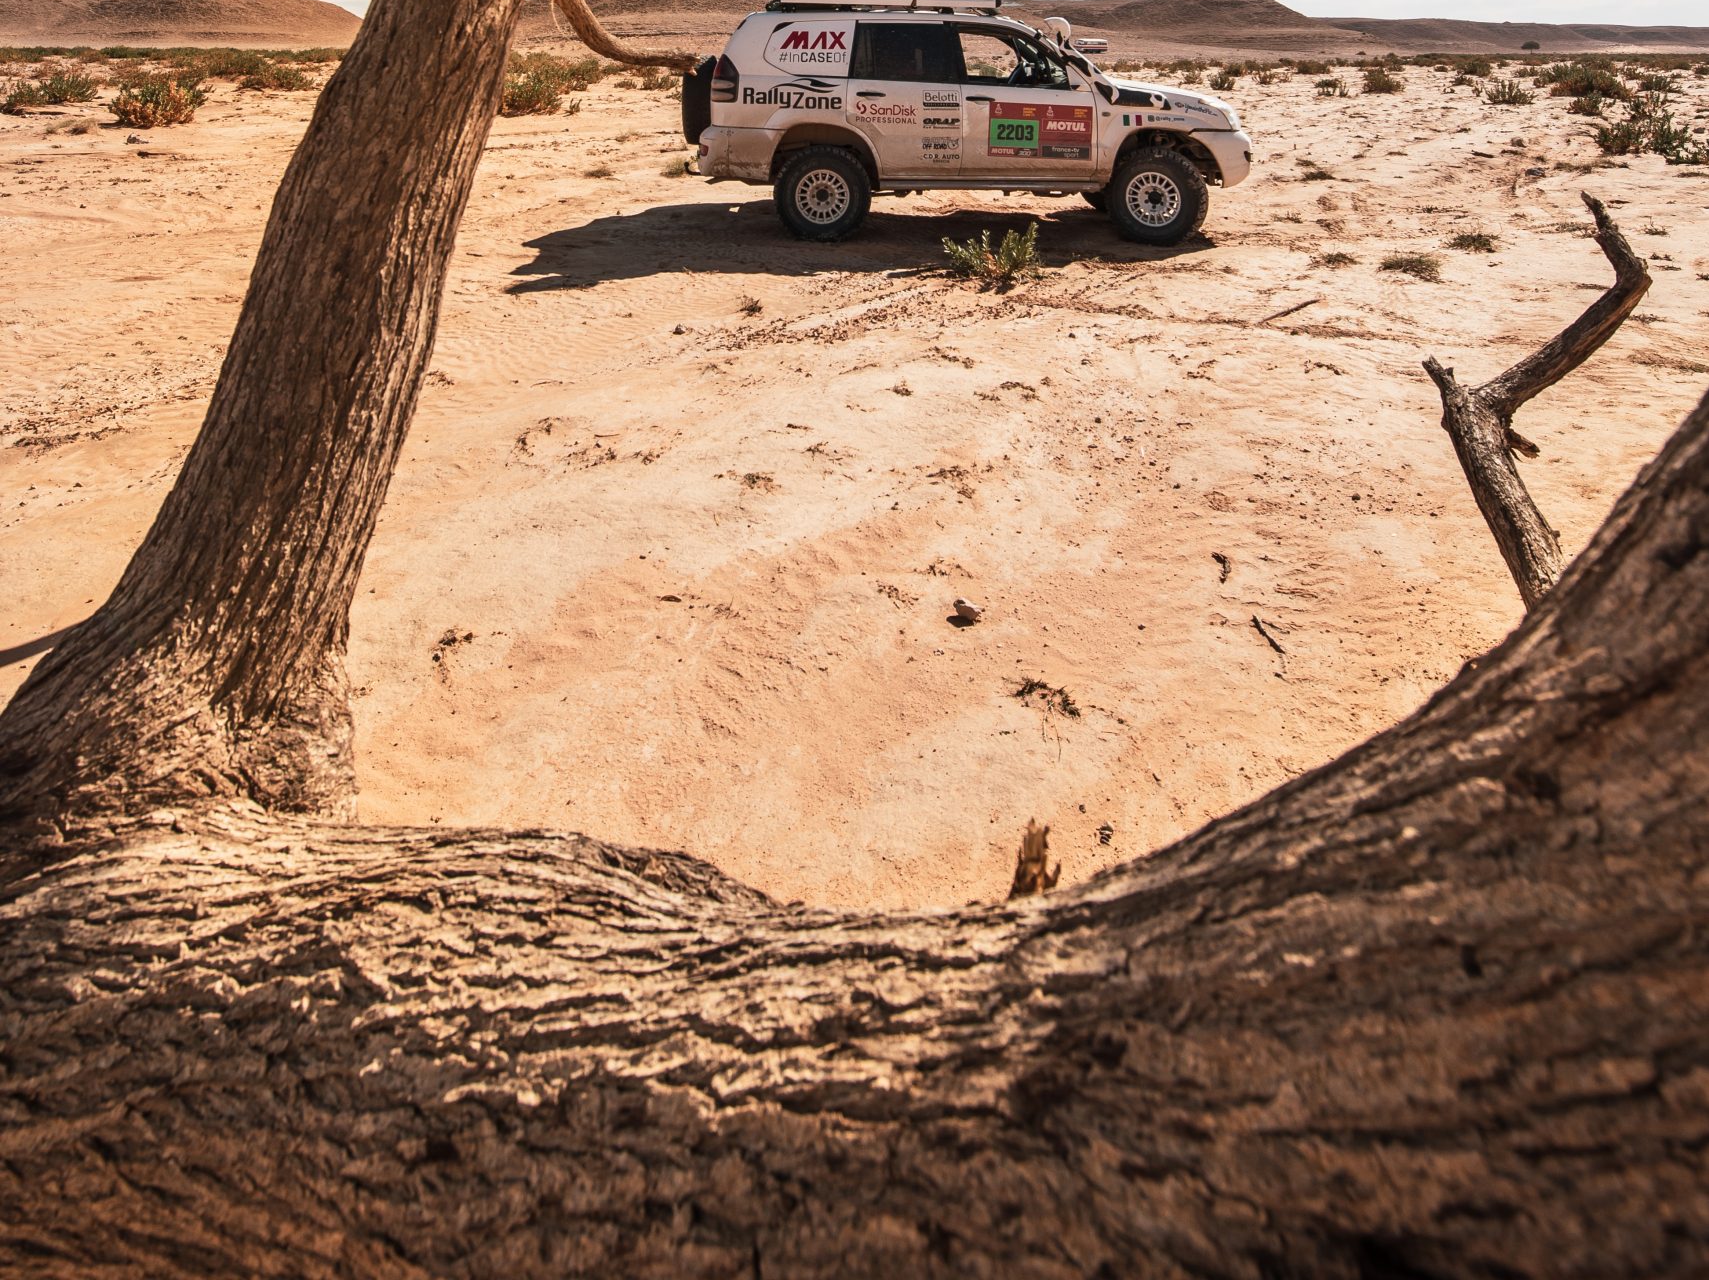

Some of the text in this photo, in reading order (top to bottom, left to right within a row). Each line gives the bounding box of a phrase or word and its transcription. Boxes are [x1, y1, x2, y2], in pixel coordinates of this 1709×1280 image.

[780, 31, 847, 50] MAX
[779, 52, 847, 63] #InCASEOf
[742, 87, 842, 109] RallyZone
[924, 92, 958, 102] Belotti
[870, 103, 917, 116] SanDisk
[855, 116, 917, 125] PROFESSIONAL
[1046, 120, 1086, 132] MOTUL
[997, 123, 1034, 141] 2203
[991, 147, 1015, 155] MOTUL
